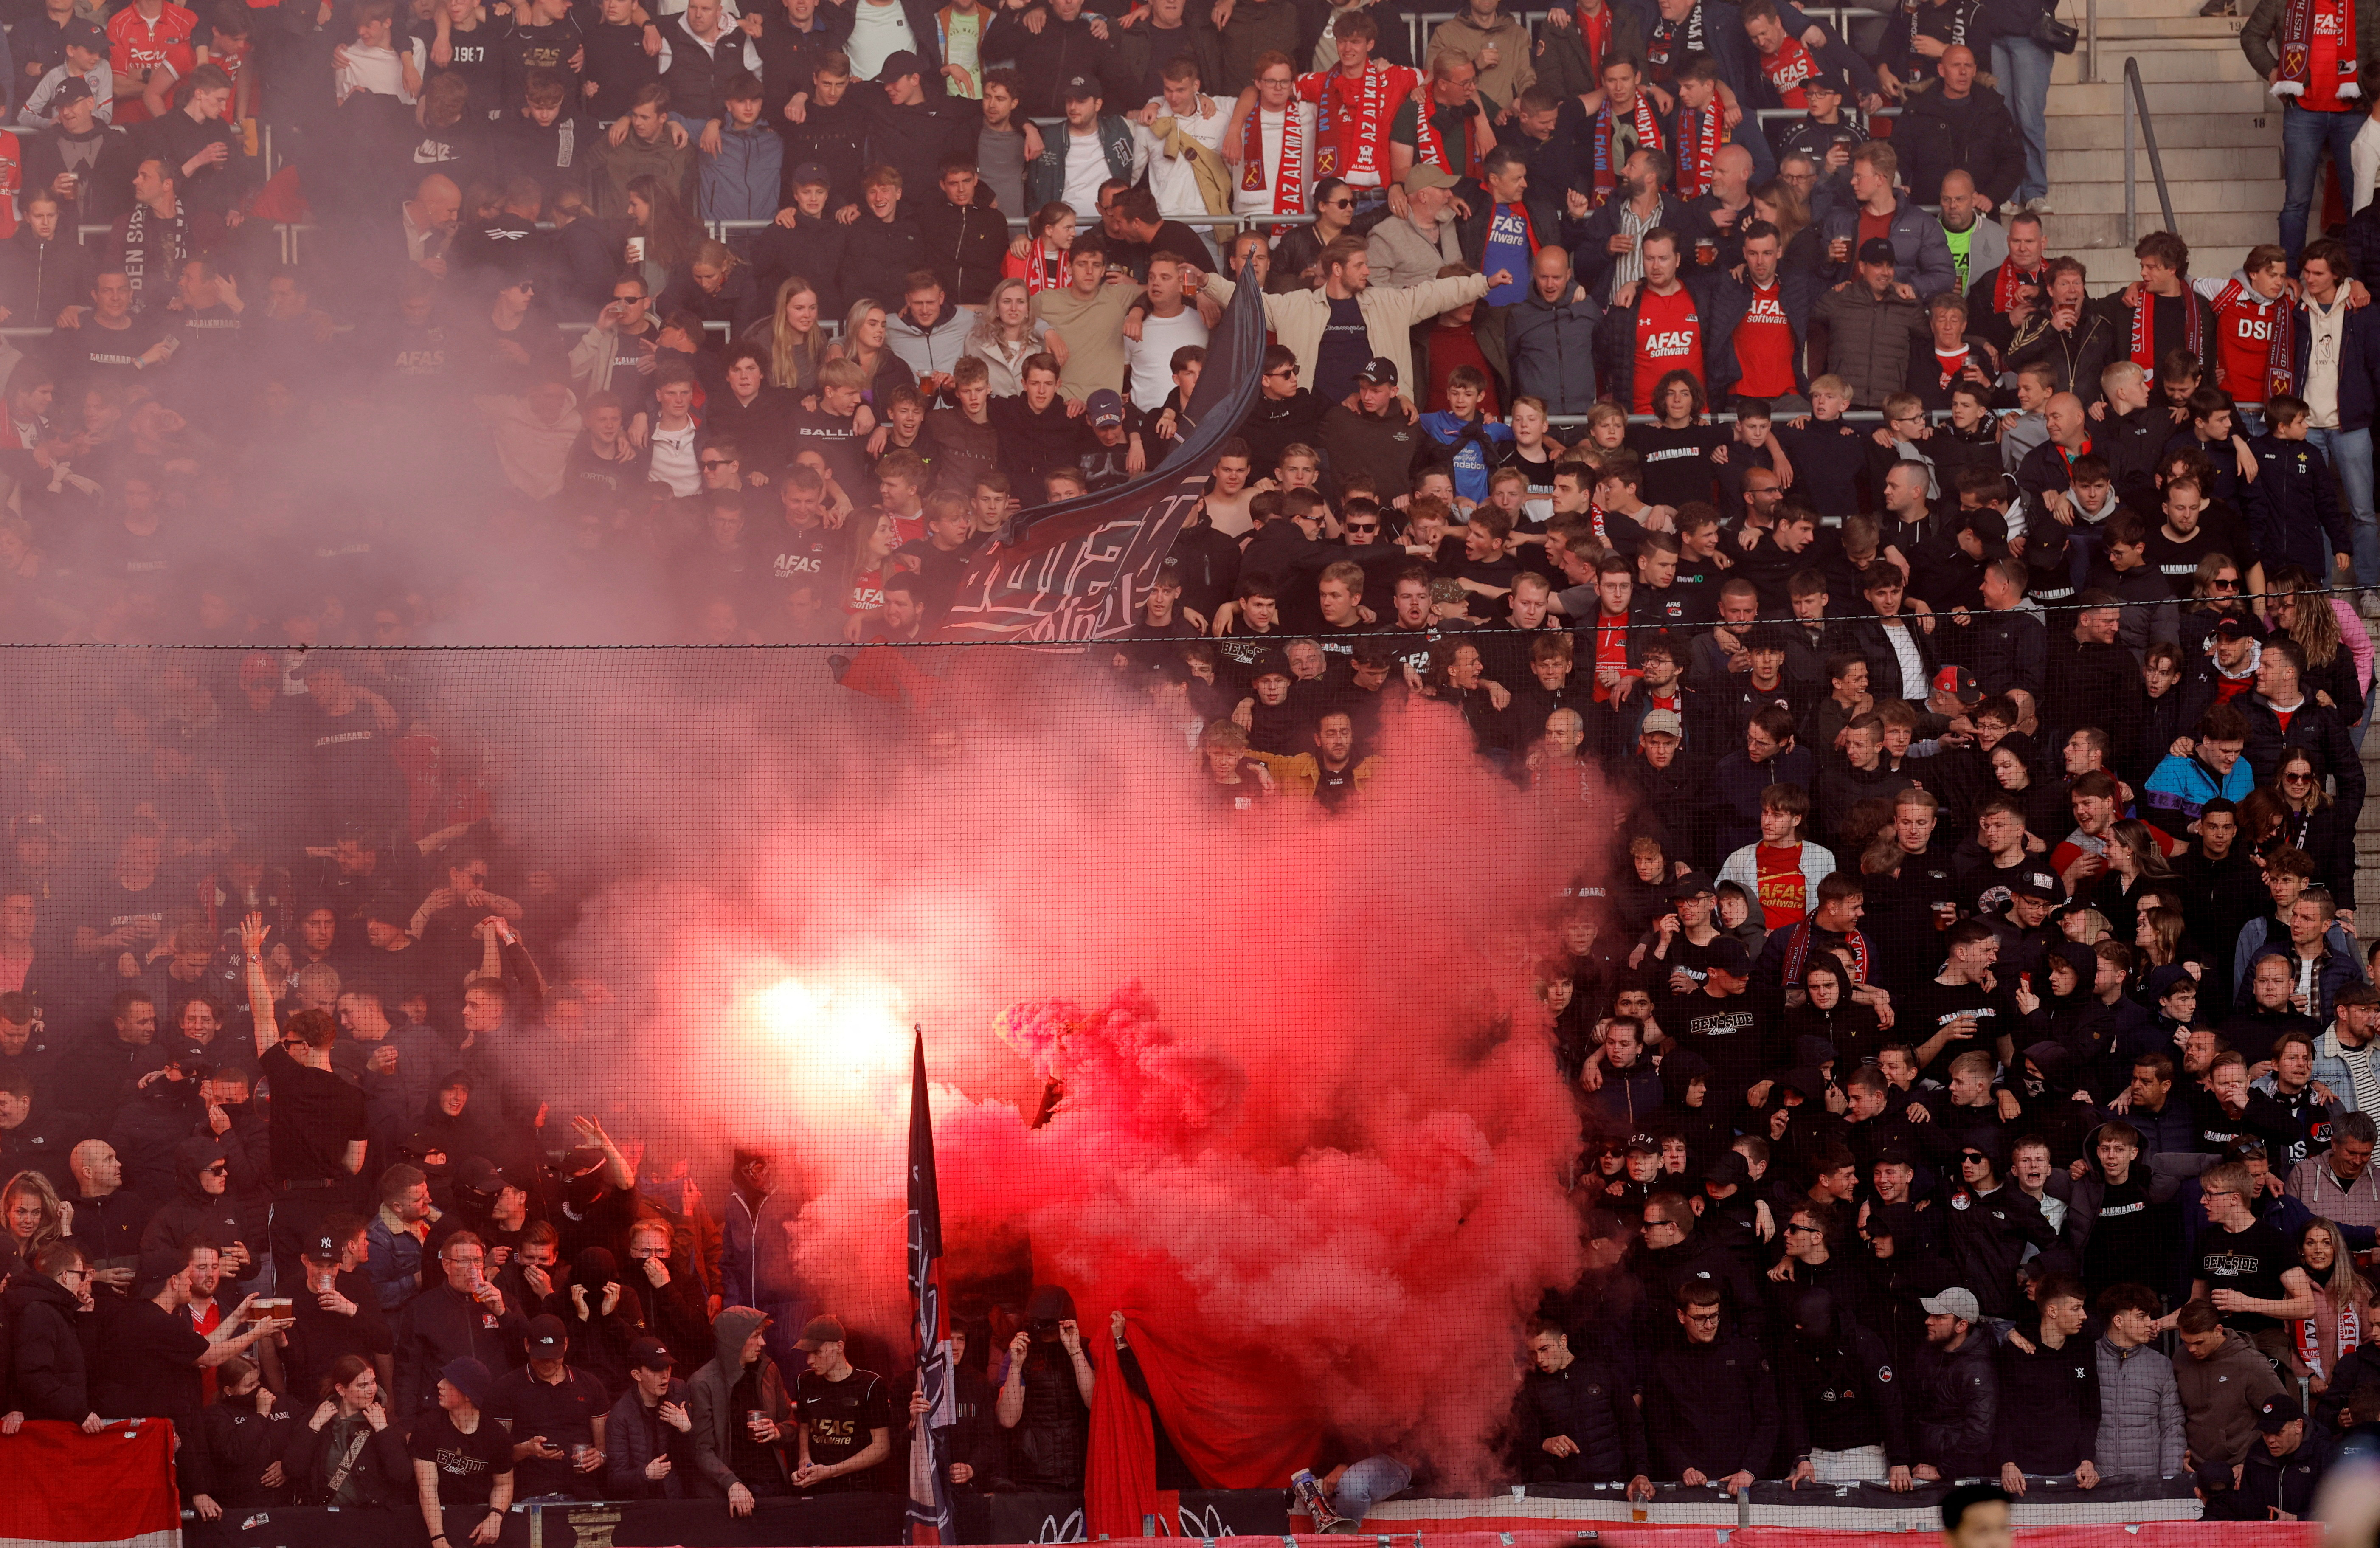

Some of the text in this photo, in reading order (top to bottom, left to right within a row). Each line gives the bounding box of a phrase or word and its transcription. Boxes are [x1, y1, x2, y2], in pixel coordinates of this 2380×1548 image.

[2229, 22, 2240, 32] 19
[2314, 14, 2337, 28] FA
[525, 48, 560, 61] FAS
[1772, 59, 1809, 86] AFAS
[2253, 119, 2265, 129] 18
[1360, 121, 1376, 142] AZ
[1282, 183, 1300, 204] AZ
[1491, 215, 1525, 234] FAS
[1490, 231, 1523, 247] ftware
[125, 249, 144, 290] DEN
[1747, 314, 1788, 324] software
[1646, 331, 1693, 352] AFAS
[396, 351, 445, 366] AFAS
[1650, 346, 1689, 358] software
[1654, 448, 1691, 461] ALKMAAR
[2298, 464, 2307, 474] TS
[773, 554, 821, 573] AFAS
[1759, 883, 1806, 901] AFAS
[1761, 899, 1803, 910] software
[1690, 1013, 1754, 1033] BEN-SIDE
[1708, 1024, 1737, 1035] Loyals
[1628, 1134, 1654, 1146] ICON
[2101, 1203, 2137, 1216] ALKMAAR
[321, 1236, 332, 1248] NY
[2204, 1255, 2259, 1272] BEN-SIDE
[2214, 1266, 2239, 1277] Loyals
[812, 1435, 852, 1445] software
